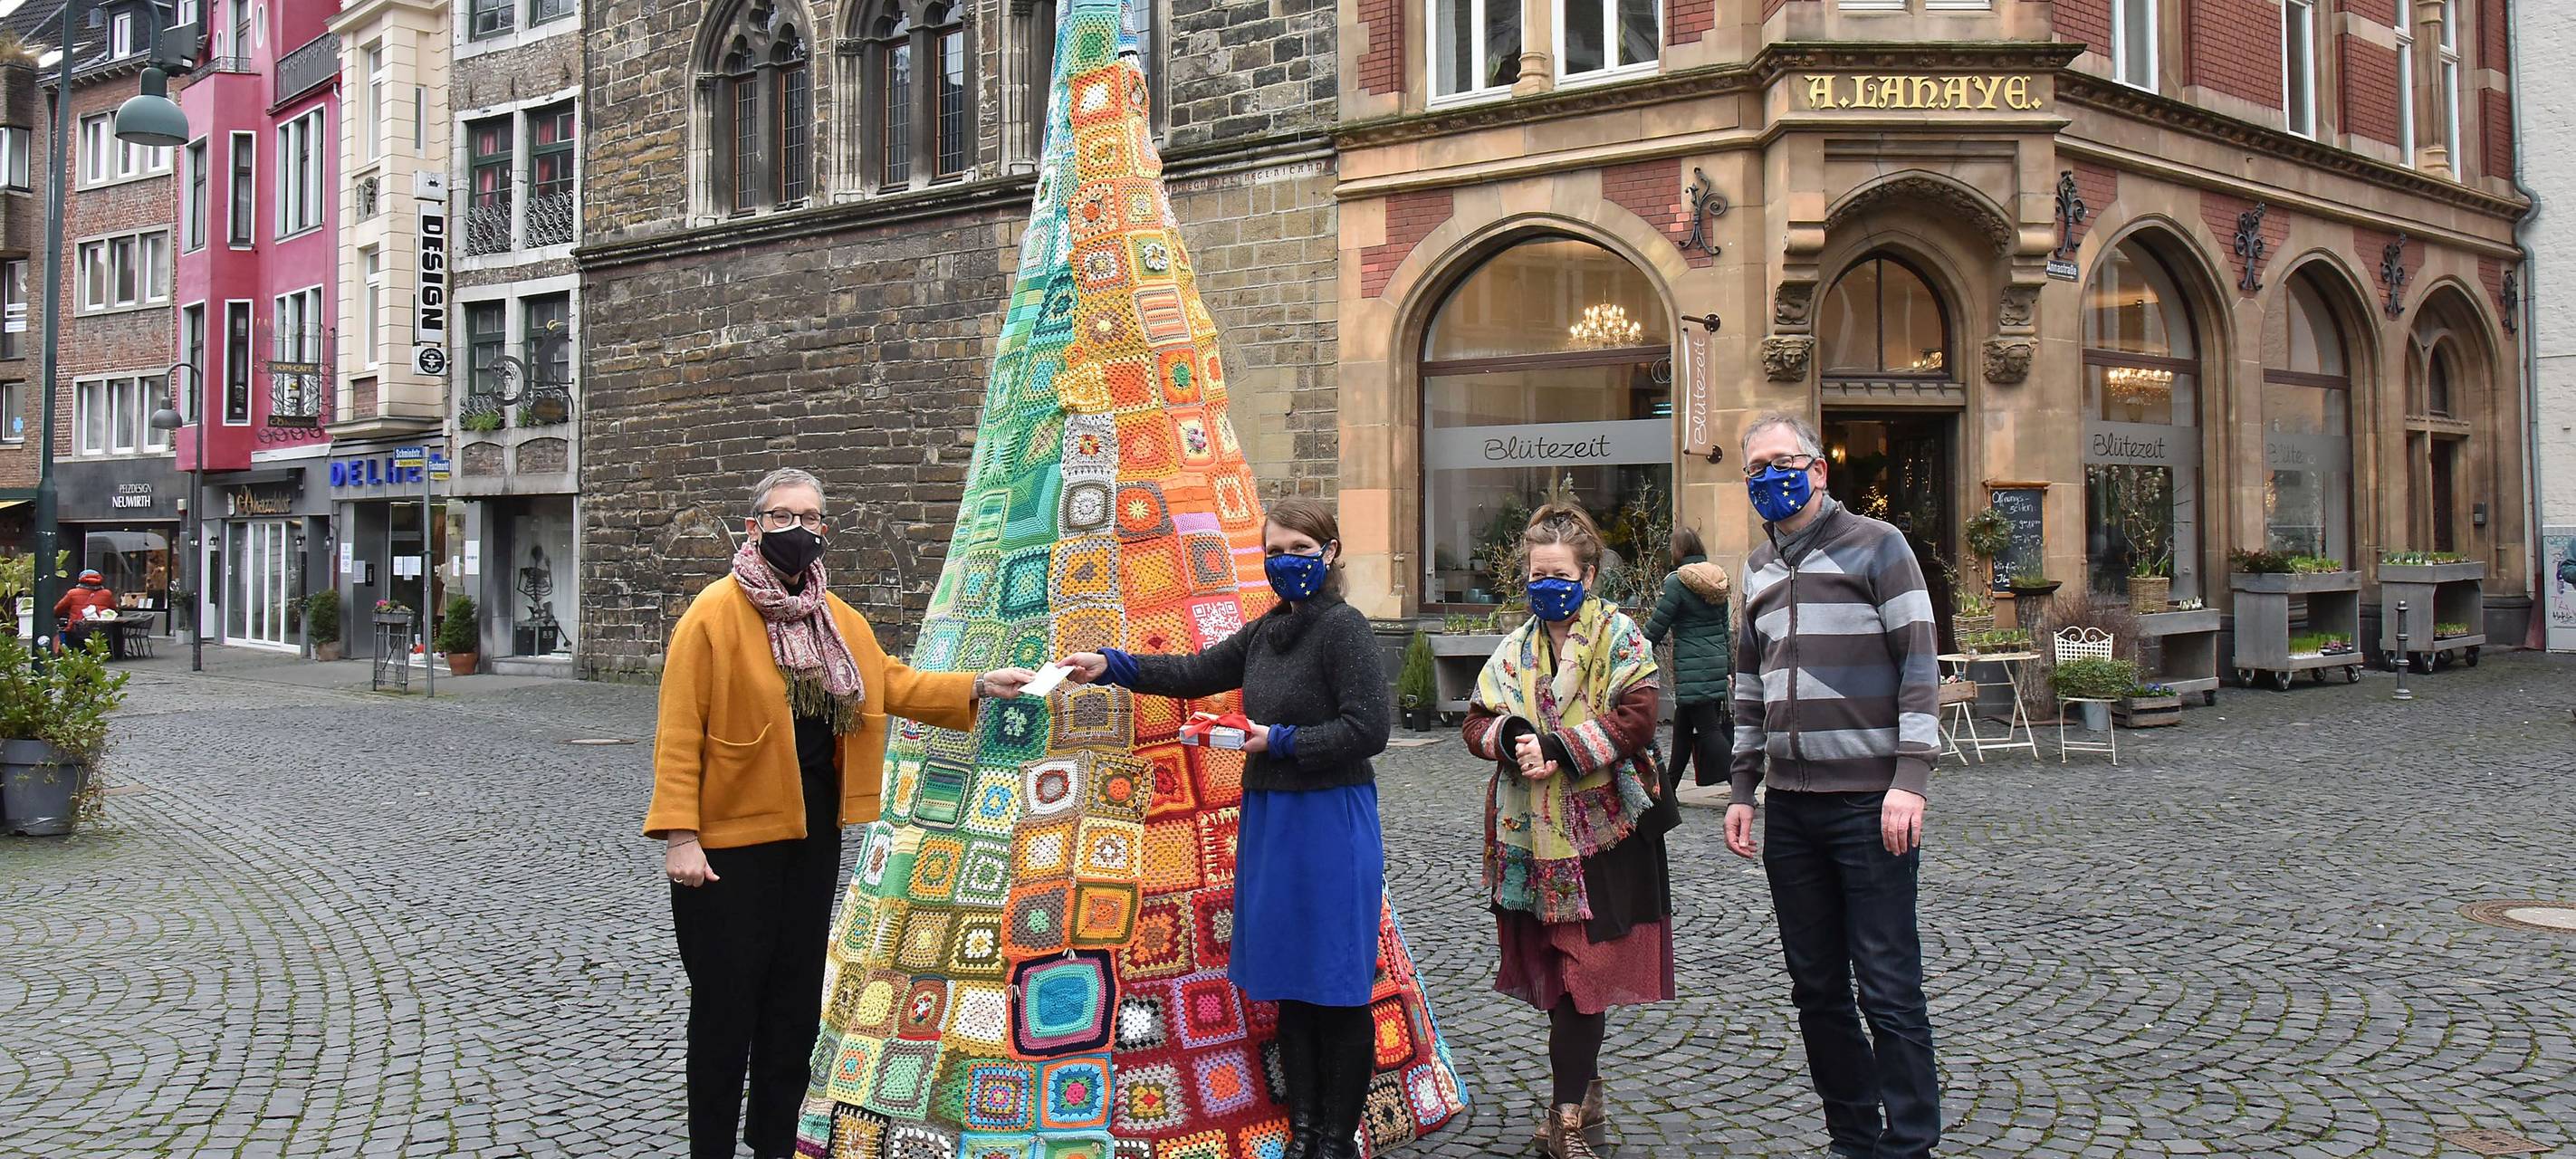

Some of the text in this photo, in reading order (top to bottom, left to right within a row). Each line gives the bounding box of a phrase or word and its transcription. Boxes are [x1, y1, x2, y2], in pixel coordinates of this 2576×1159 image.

[422, 215, 444, 330] DESIGN
[2047, 261, 2077, 275] Annastraße
[1692, 337, 1707, 445] Blütezeit
[396, 448, 422, 458] Schmiedstr.
[1484, 435, 1612, 461] Blütezeit
[2093, 432, 2166, 459] Blütezeit
[330, 454, 441, 486] DELHE
[119, 483, 152, 493] PELZDESIGN
[112, 495, 151, 508] NEUWIRTH
